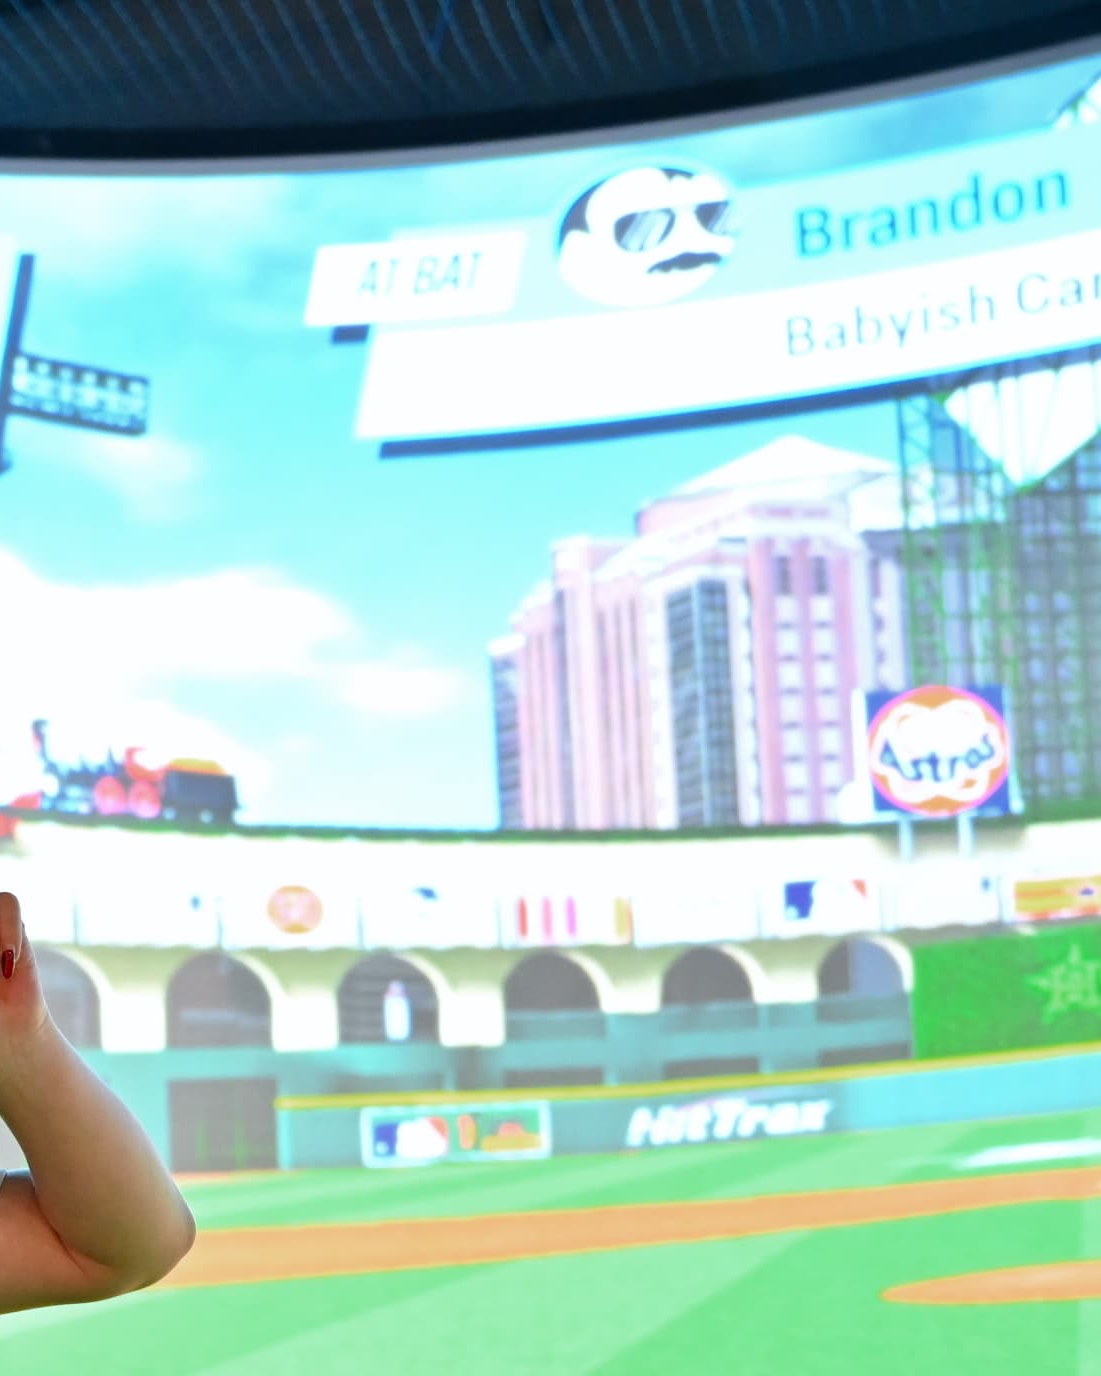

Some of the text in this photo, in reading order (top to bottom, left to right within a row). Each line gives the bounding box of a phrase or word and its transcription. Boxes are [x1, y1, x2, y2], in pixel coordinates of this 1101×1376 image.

[795, 168, 1068, 258] Brandon
[356, 249, 485, 297] AT BAT
[786, 285, 996, 357] Babyish
[879, 733, 996, 783] Astros
[626, 1097, 832, 1147] HitTrax
